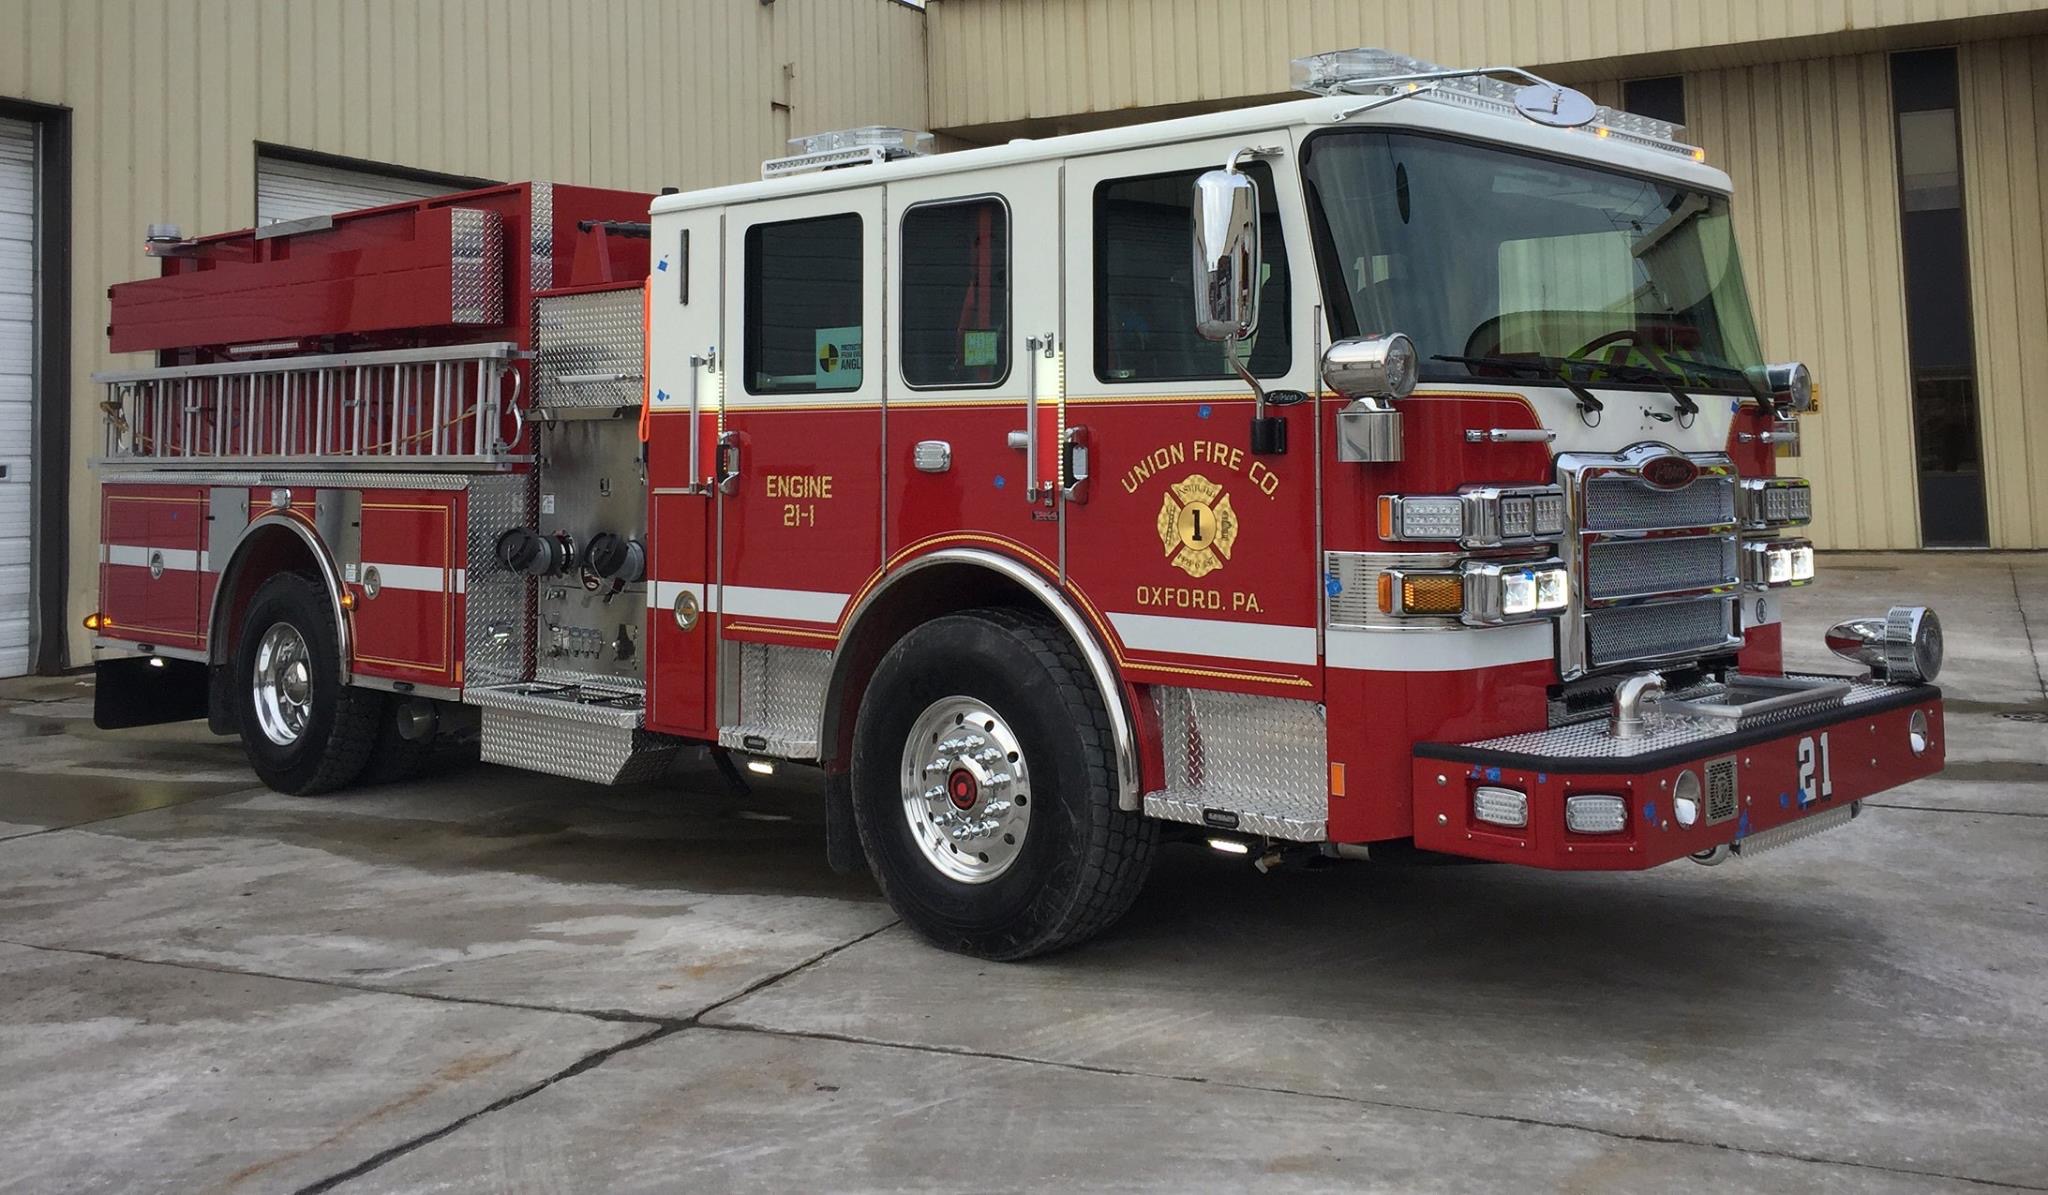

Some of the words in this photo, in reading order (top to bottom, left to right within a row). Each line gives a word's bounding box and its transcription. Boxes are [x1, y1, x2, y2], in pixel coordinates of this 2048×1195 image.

[1121, 442, 1185, 494] UNION
[1193, 440, 1245, 472] FIRE
[1248, 461, 1280, 501] CO.
[766, 475, 833, 499] ENGINE
[783, 503, 815, 527] 21-1
[1192, 509, 1203, 542] 1
[1232, 591, 1265, 613] PA.
[1798, 731, 1833, 805] 21
